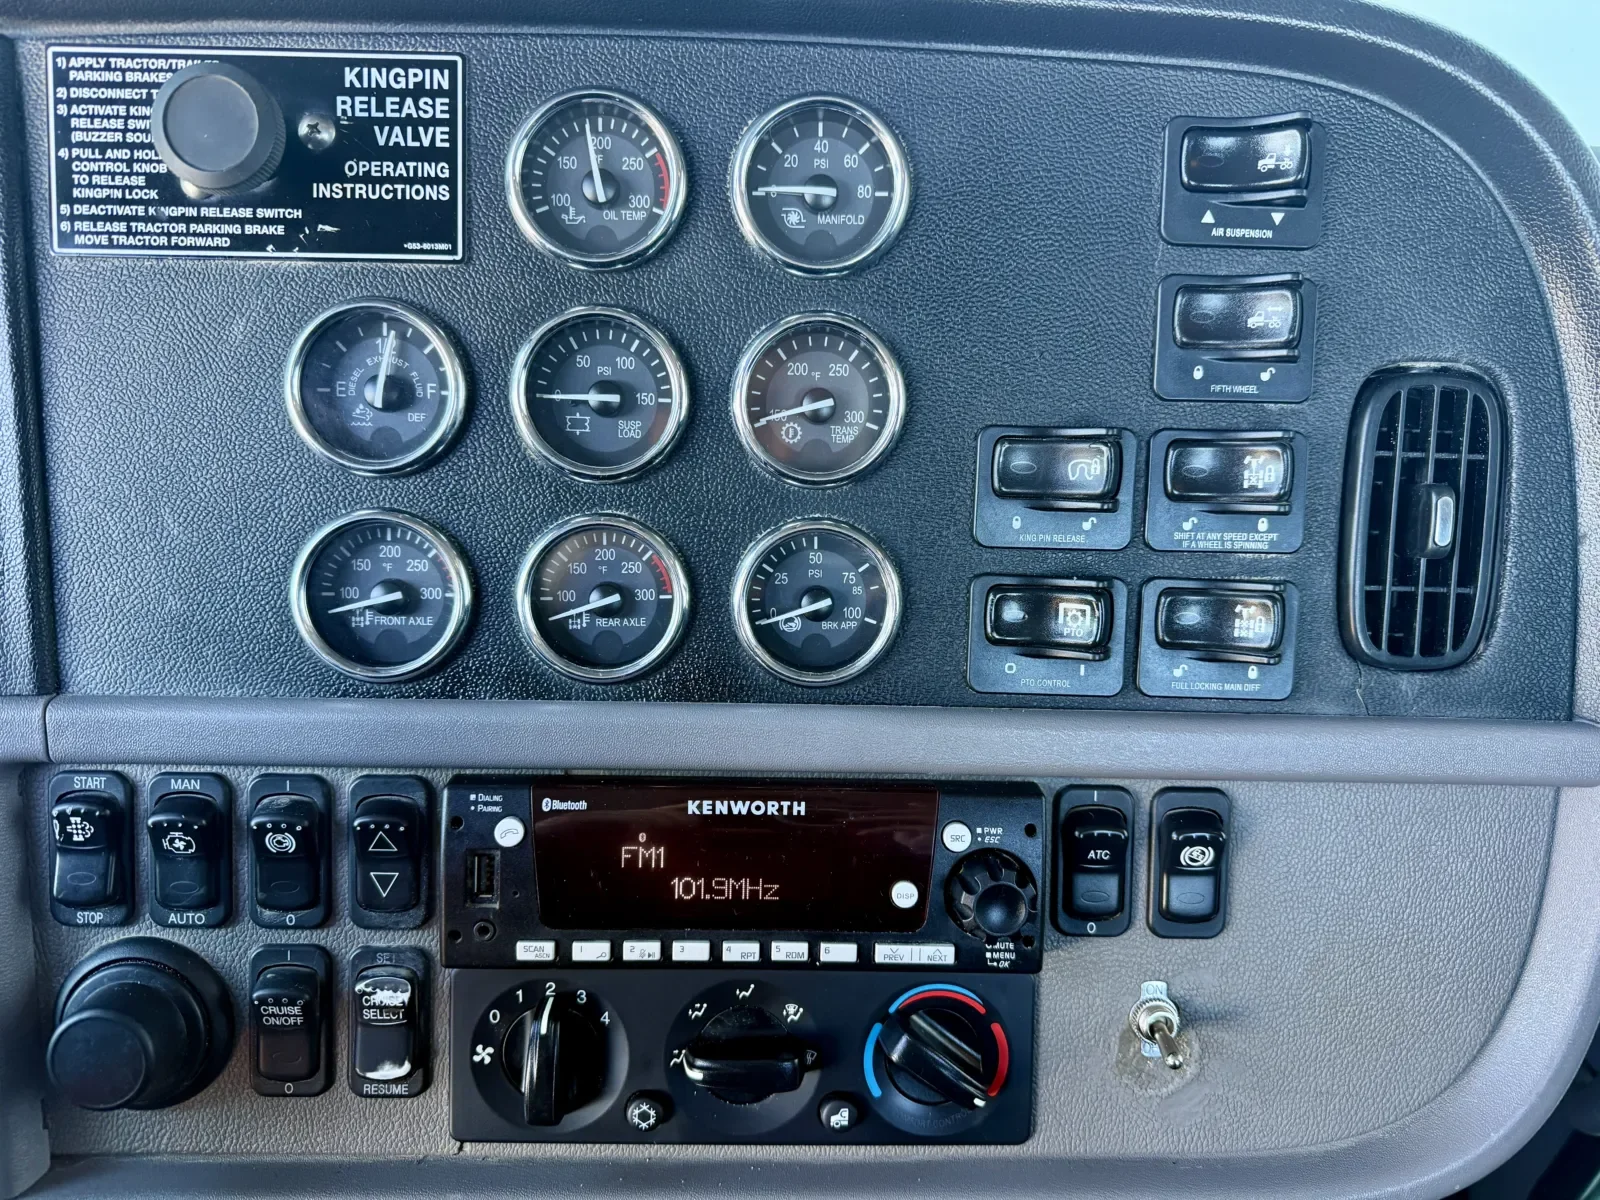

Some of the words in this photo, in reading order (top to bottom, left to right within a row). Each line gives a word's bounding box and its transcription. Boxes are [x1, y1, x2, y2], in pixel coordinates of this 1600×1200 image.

[56, 56, 67, 69] 1)
[68, 57, 107, 68] APPLY
[69, 70, 122, 82] PARKING
[344, 67, 450, 90] KINGPIN
[56, 87, 67, 100] 2)
[70, 88, 148, 100] DISCONNECT
[56, 104, 68, 116] 3)
[70, 104, 126, 116] ACTIVATE
[336, 96, 450, 118] RELEASE
[70, 118, 125, 129] RELEASE
[71, 131, 123, 144] (BUZZER
[374, 126, 450, 148] VALVE
[814, 140, 828, 154] 40
[58, 148, 69, 160] 4)
[72, 148, 102, 158] PULL
[105, 149, 130, 159] AND
[557, 156, 578, 170] 150
[622, 158, 644, 171] 250
[784, 154, 798, 168] 20
[814, 159, 829, 168] PSI
[844, 154, 858, 168] 60
[72, 162, 130, 172] CONTROL
[133, 163, 168, 173] KNOB
[344, 161, 450, 178] OPERATING
[72, 174, 90, 184] TO
[92, 176, 146, 186] RELEASE
[73, 188, 122, 198] KINGPIN
[125, 189, 159, 199] LOCK
[312, 182, 450, 200] INSTRUCTIONS
[857, 185, 872, 198] 80
[551, 193, 571, 206] 100
[628, 194, 650, 208] 300
[60, 204, 70, 216] 5)
[73, 205, 146, 216] DEACTIVATE
[200, 207, 254, 218] RELEASE
[256, 208, 302, 218] SWITCH
[602, 210, 618, 220] OIL
[620, 210, 647, 220] TEMP
[817, 215, 865, 225] MANIFOLD
[60, 222, 71, 233] 6)
[74, 222, 128, 232] RELEASE
[130, 222, 187, 233] TRACTOR
[190, 224, 242, 234] PARKING
[244, 225, 285, 235] BRAKE
[1211, 228, 1224, 237] AIR
[1226, 228, 1272, 238] SUSPENSION
[74, 235, 109, 245] MOVE
[111, 236, 168, 246] TRACTOR
[171, 236, 230, 247] FORWARD
[576, 355, 590, 368] 50
[615, 356, 636, 370] 100
[597, 366, 612, 376] PSI
[787, 362, 808, 376] 200
[828, 364, 850, 377] 250
[336, 381, 347, 397] E
[410, 371, 424, 398] FLUID
[1210, 384, 1232, 393] FIFTH
[1232, 385, 1259, 394] WHEEL
[426, 383, 436, 399] F
[636, 392, 655, 406] 150
[408, 412, 426, 422] DEF
[844, 410, 864, 424] 300
[618, 420, 642, 430] SUSP
[830, 426, 859, 435] TRANS
[618, 429, 642, 438] LOAD
[831, 434, 855, 444] TEMP
[1020, 534, 1036, 542] KING
[1038, 534, 1050, 542] PIN
[1052, 534, 1086, 542] RELEASE
[1174, 532, 1196, 540] SHIFT
[1196, 532, 1206, 540] AT
[1206, 532, 1222, 540] ANY
[1223, 532, 1247, 540] SPEED
[1249, 533, 1278, 541] EXCEPT
[1197, 541, 1222, 549] WHEEL
[1224, 541, 1232, 549] IS
[1233, 542, 1269, 550] SPINNING
[380, 546, 401, 558] 200
[594, 548, 616, 561] 200
[808, 552, 822, 564] 50
[352, 558, 372, 572] 150
[406, 560, 428, 572] 250
[568, 562, 587, 574] 150
[621, 562, 642, 574] 250
[774, 572, 788, 584] 25
[808, 570, 823, 578] PSI
[842, 572, 856, 584] 75
[340, 586, 360, 599] 100
[420, 588, 442, 600] 300
[556, 590, 576, 602] 100
[634, 588, 656, 601] 300
[852, 586, 862, 595] 85
[843, 607, 862, 618] 100
[374, 616, 407, 626] FRONT
[408, 616, 434, 626] AXLE
[596, 618, 620, 627] REAR
[622, 618, 646, 626] AXLE
[822, 622, 838, 630] BRK
[840, 622, 858, 630] APP
[1063, 628, 1084, 637] PTO
[1020, 678, 1034, 687] PTO
[1038, 679, 1071, 688] CONTROL
[1172, 682, 1188, 690] FULL
[1190, 682, 1222, 691] LOCKING
[1224, 683, 1242, 691] MAIN
[1244, 684, 1262, 692] DIFF
[74, 776, 106, 789] START
[170, 778, 200, 790] MAN
[552, 800, 588, 810] Bluetooth
[688, 800, 806, 816] KENWORTH
[950, 834, 966, 843] SRC
[621, 846, 664, 868] FM1
[1088, 850, 1111, 860] ATC
[670, 878, 780, 900] 101.9MHz
[76, 912, 104, 924] STOP
[168, 913, 206, 924] AUTO
[740, 952, 756, 960] RPT
[884, 954, 904, 962] PREV
[927, 954, 948, 962] NEXT
[992, 951, 1016, 960] MENU
[545, 982, 556, 996] 2
[1146, 984, 1163, 996] ON
[516, 988, 523, 1004] 1
[576, 990, 587, 1004] 3
[260, 1006, 302, 1015] CRUISE
[362, 1008, 404, 1020] SELECT
[489, 1009, 500, 1024] 0
[262, 1016, 304, 1026] ON/OFF
[600, 1011, 610, 1025] 4
[364, 1084, 408, 1095] RESUME
